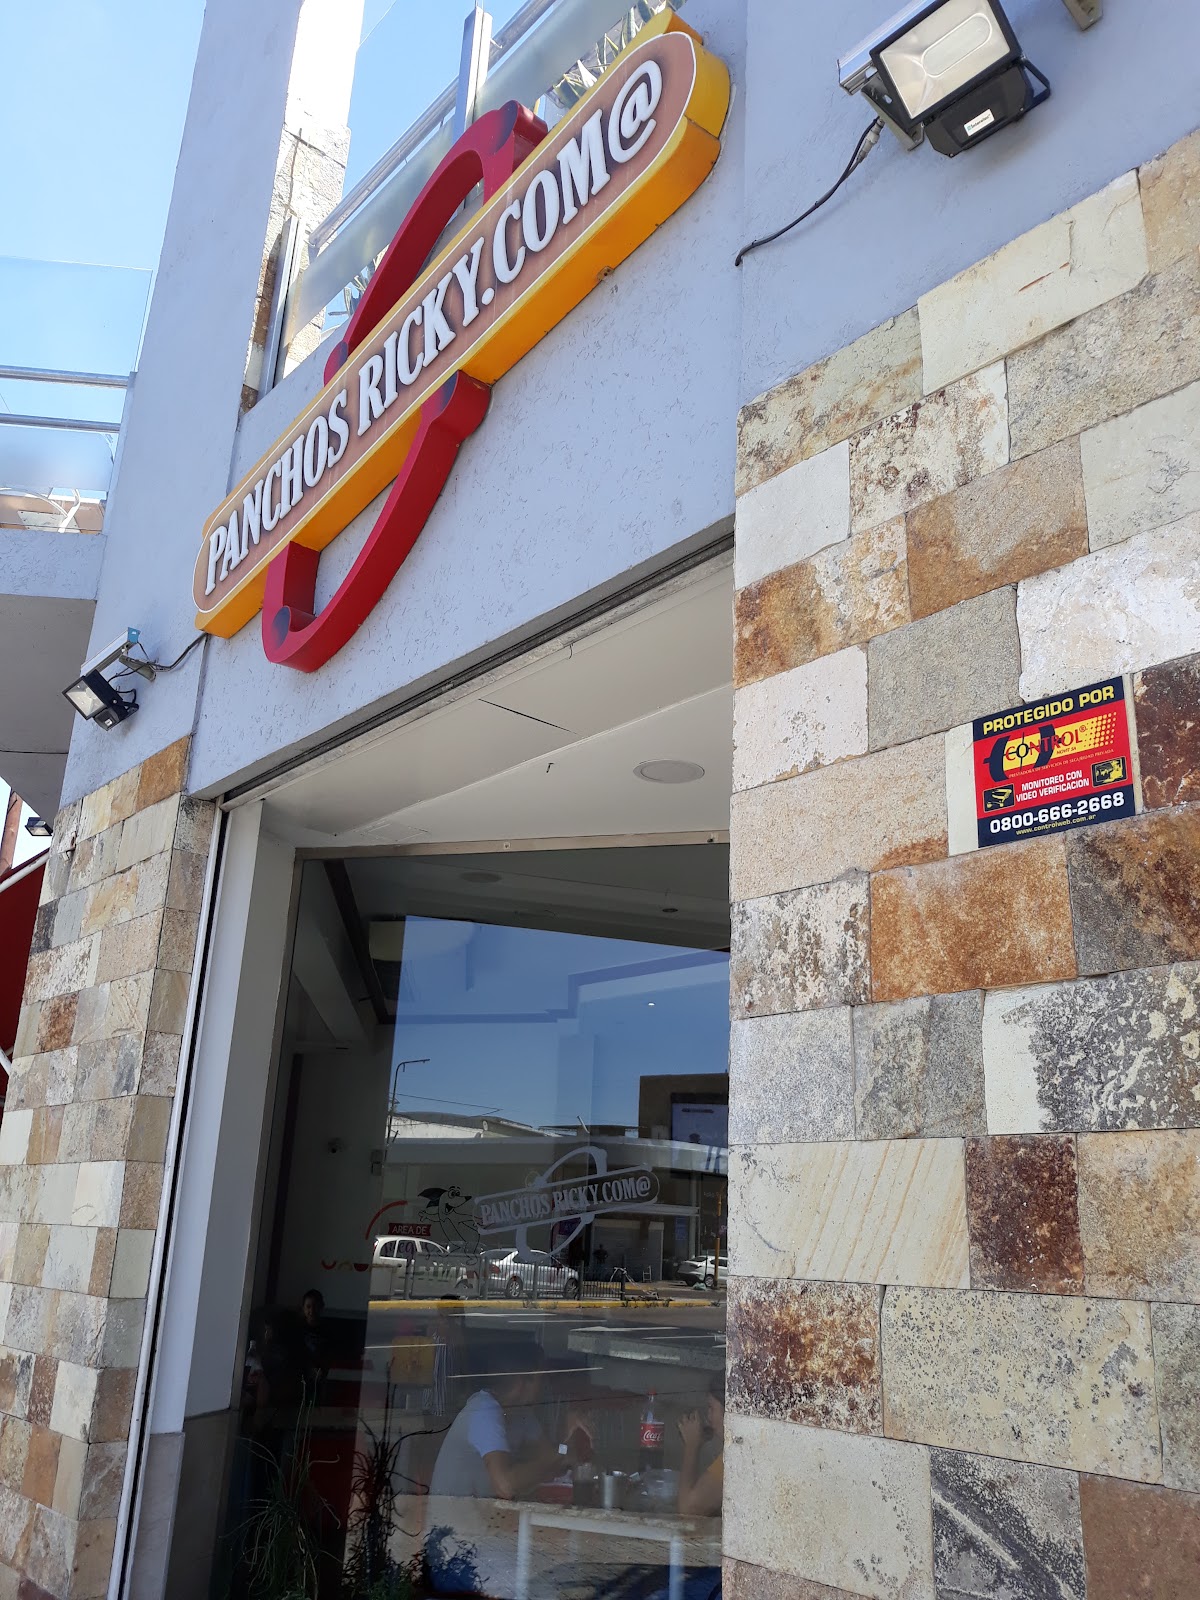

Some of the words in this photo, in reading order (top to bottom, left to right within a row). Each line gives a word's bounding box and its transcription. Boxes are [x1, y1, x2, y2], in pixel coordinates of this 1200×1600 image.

[204, 388, 348, 596] PANCHOS
[356, 59, 663, 437] RICKY.COM@
[983, 697, 1074, 735] PROTEGIDO
[1079, 685, 1115, 708] POR
[1016, 789, 1038, 802] VIDEO
[1039, 778, 1090, 797] VERIFICACION
[1021, 773, 1065, 791] MONITOREO
[1065, 770, 1083, 782] CON
[990, 792, 1125, 834] 0800-666-2668
[1016, 814, 1097, 836] www.controlweb.com.ar
[480, 1193, 549, 1225] PANCHOS
[552, 1176, 651, 1211] RICKY.COM@
[391, 1225, 415, 1235] AREA
[415, 1225, 428, 1235] DE
